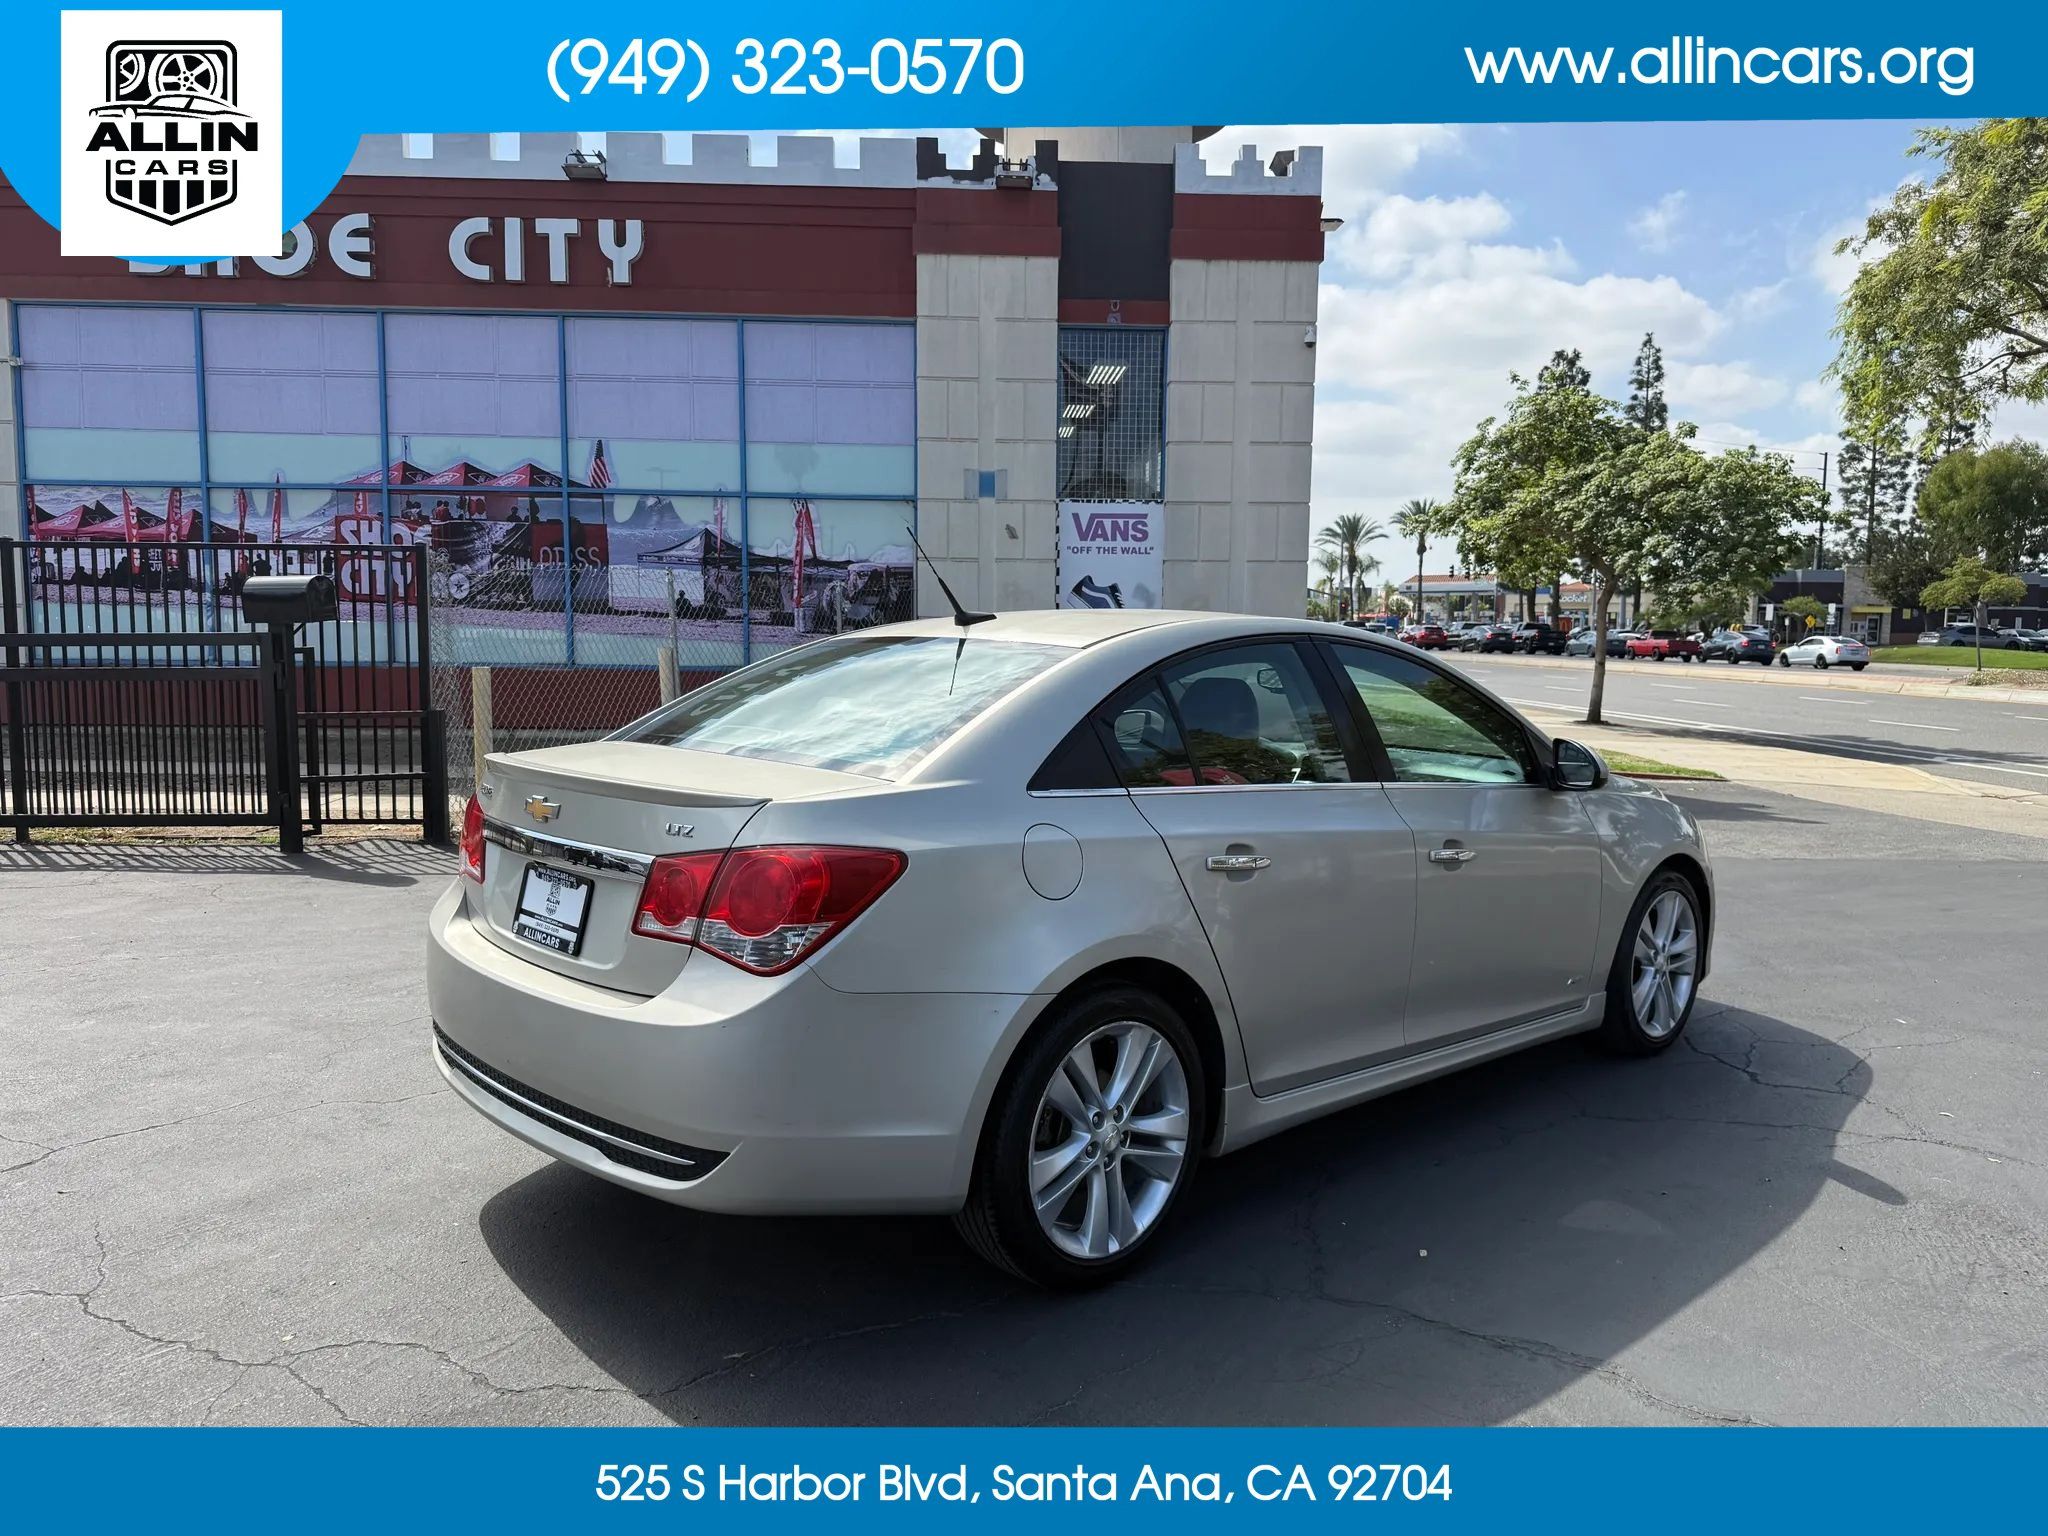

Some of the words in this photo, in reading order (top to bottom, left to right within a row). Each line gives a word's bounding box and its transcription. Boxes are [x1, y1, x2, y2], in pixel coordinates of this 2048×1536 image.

[448, 216, 645, 285] CITY
[1072, 512, 1149, 542] VANS
[1067, 545, 1092, 555] "OFF
[1096, 546, 1118, 555] THE
[1121, 546, 1154, 555] WALL"
[341, 559, 412, 597] CITY
[665, 822, 695, 838] LTZ
[523, 927, 560, 950] ALLINCARS
